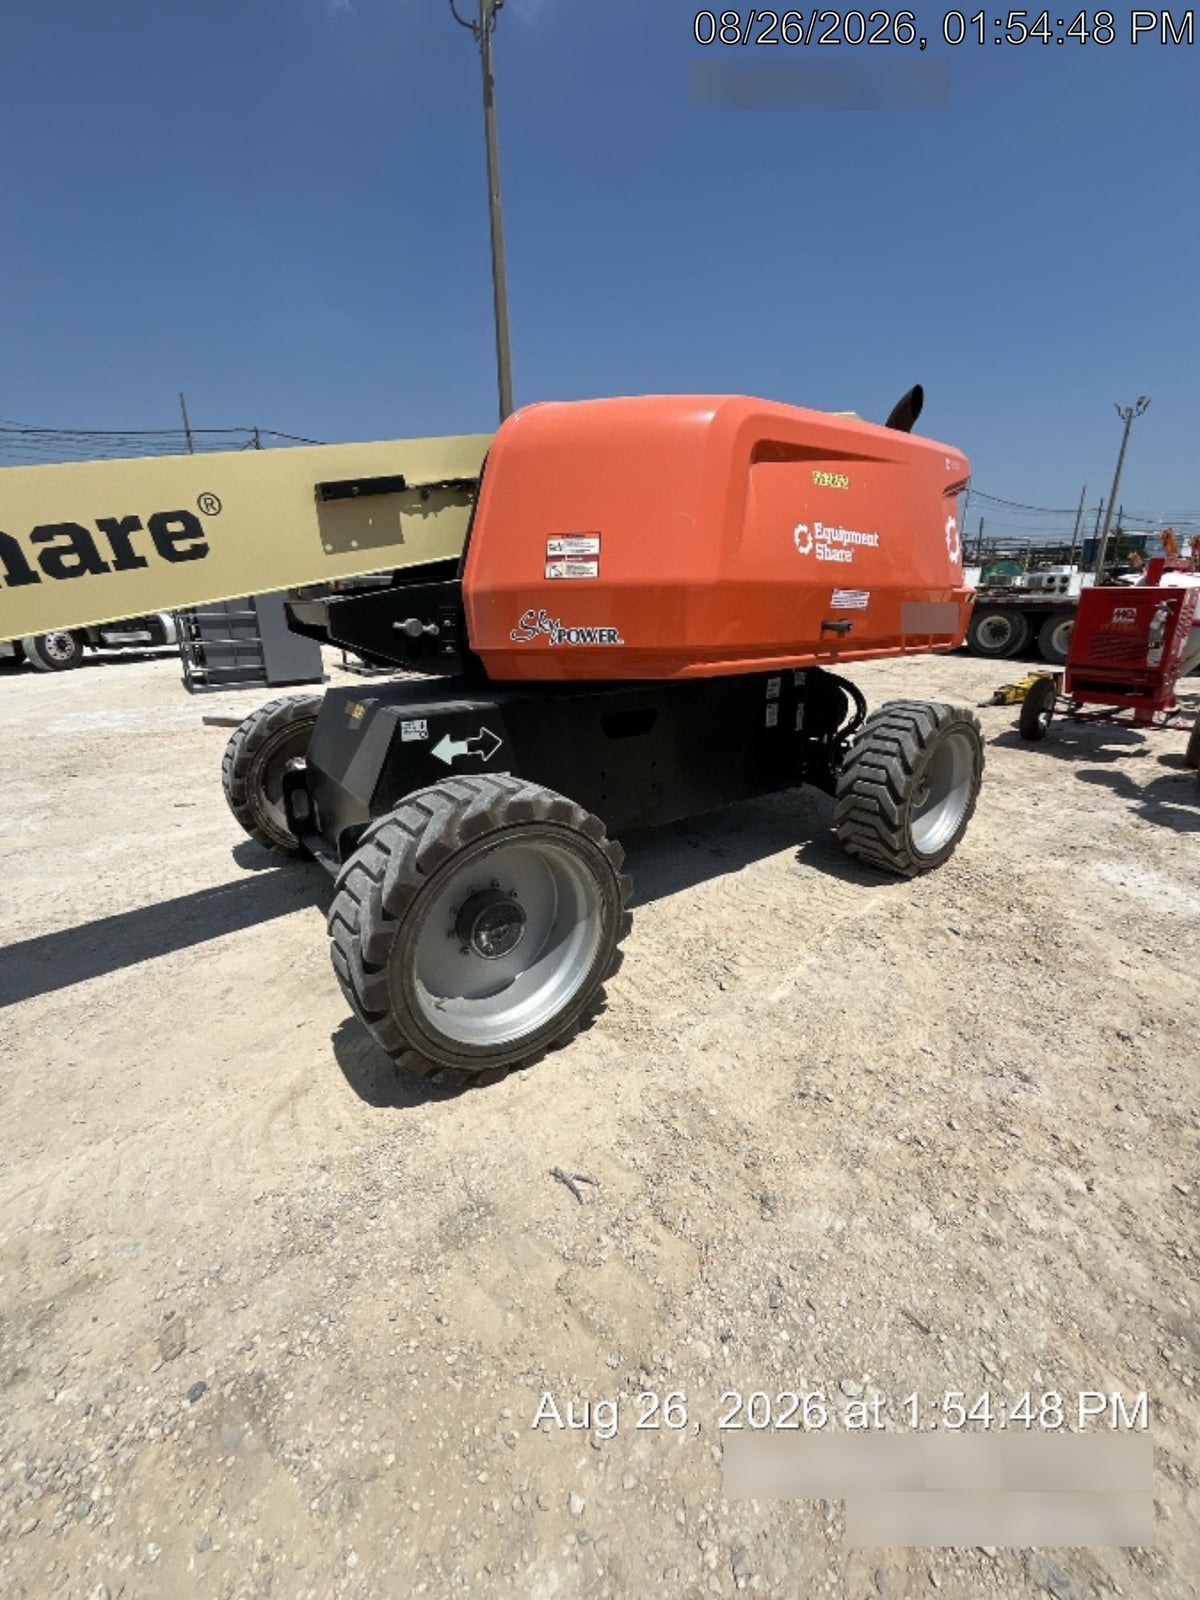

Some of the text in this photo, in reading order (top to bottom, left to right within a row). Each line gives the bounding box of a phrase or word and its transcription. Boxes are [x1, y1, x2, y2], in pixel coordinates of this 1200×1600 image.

[813, 521, 879, 548] Equipment
[815, 543, 853, 563] Share
[556, 627, 619, 645] POWER
